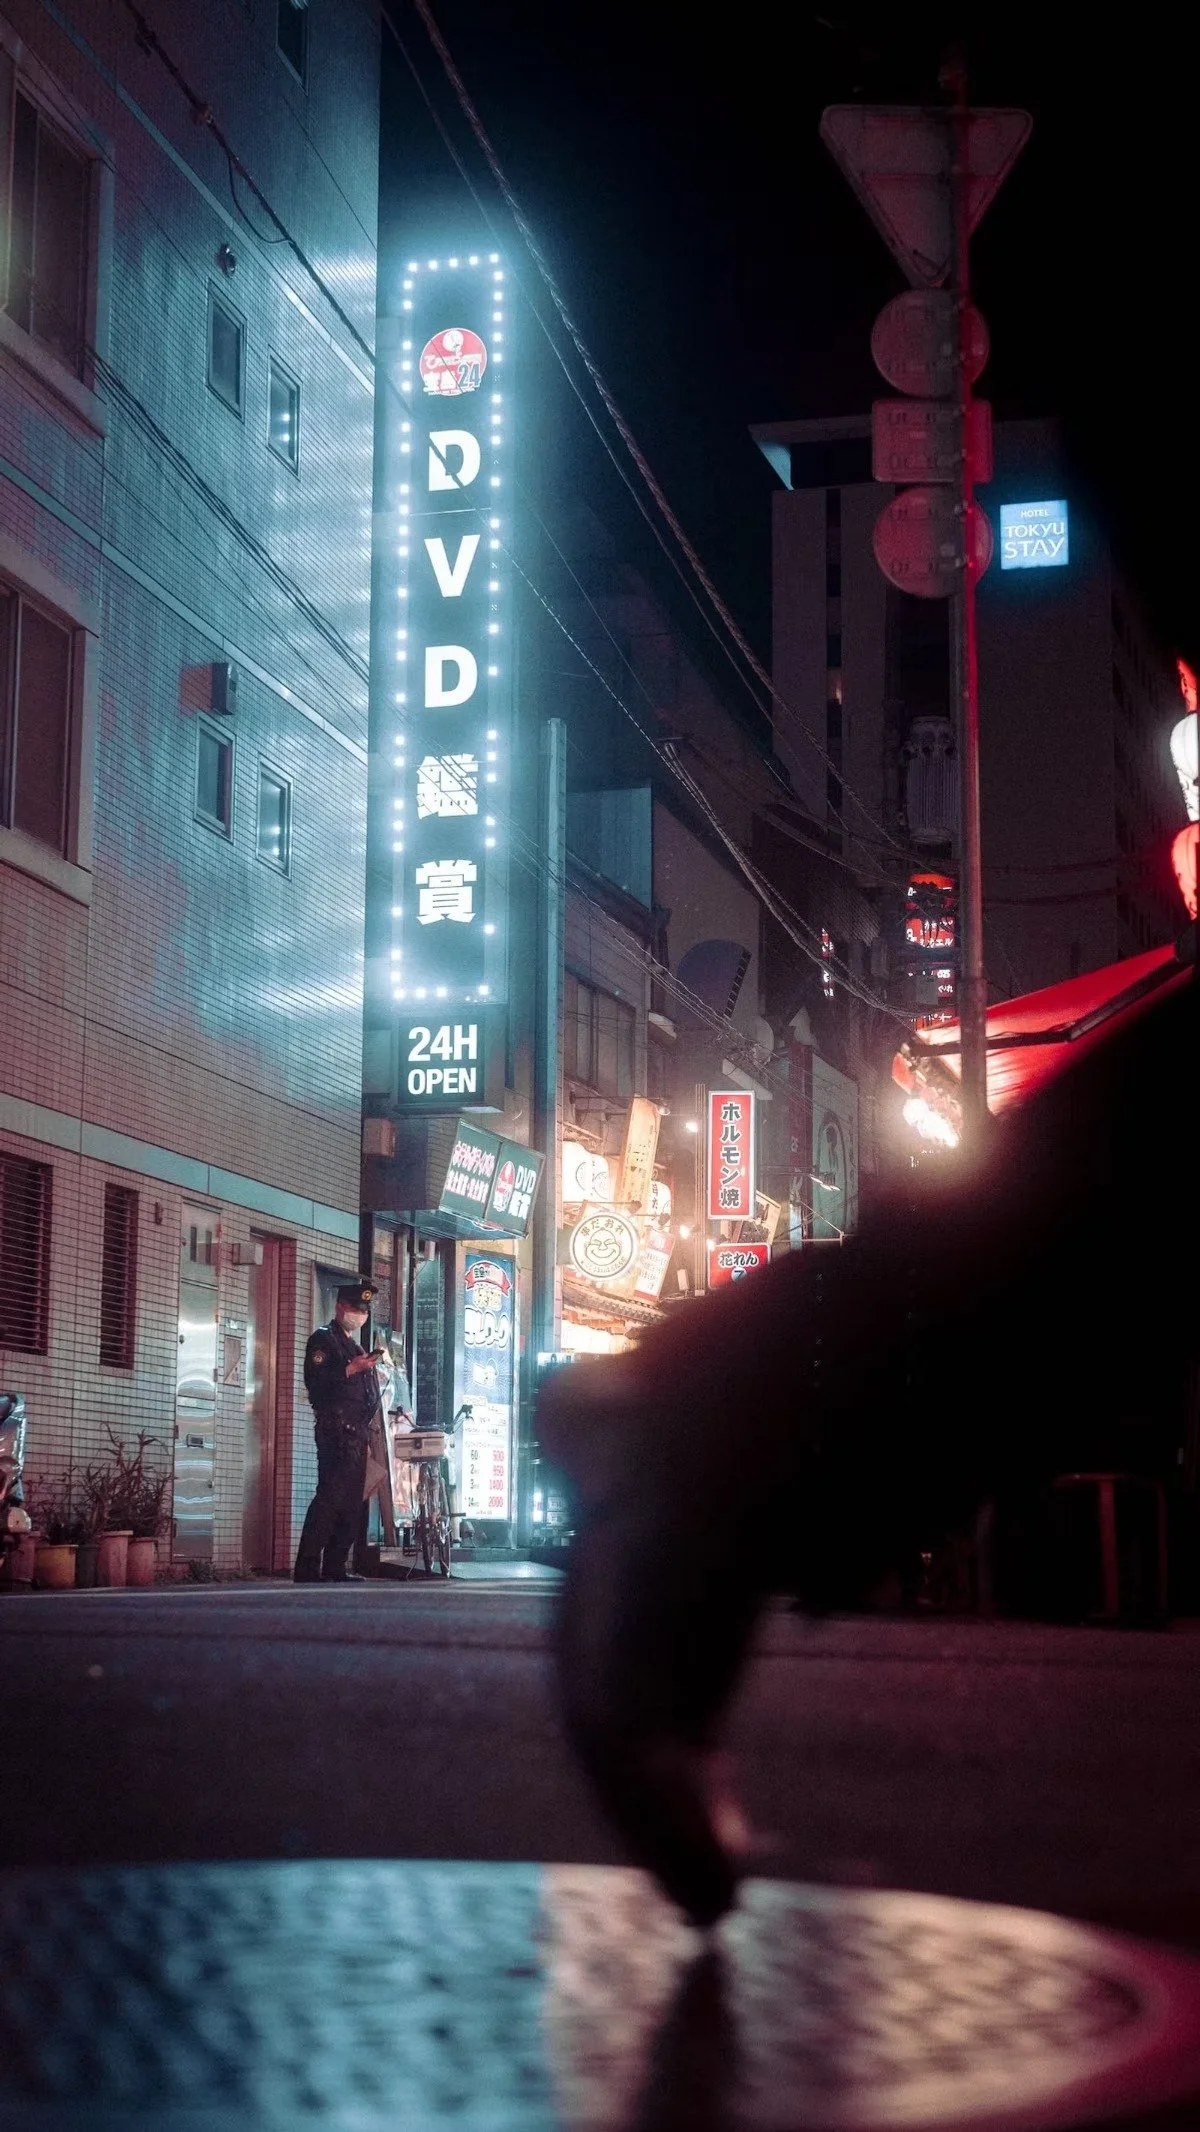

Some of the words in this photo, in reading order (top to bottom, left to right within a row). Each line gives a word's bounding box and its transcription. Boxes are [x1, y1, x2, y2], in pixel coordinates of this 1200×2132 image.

[1021, 509, 1050, 518] HOTEL
[1003, 522, 1064, 538] TOKYU
[1005, 537, 1065, 559] STAY
[408, 1024, 478, 1062] 24H
[407, 1067, 477, 1095] OPEN
[719, 1102, 742, 1209] ホルモン焼
[515, 1165, 537, 1194] DVD
[719, 1252, 758, 1267] 花れん
